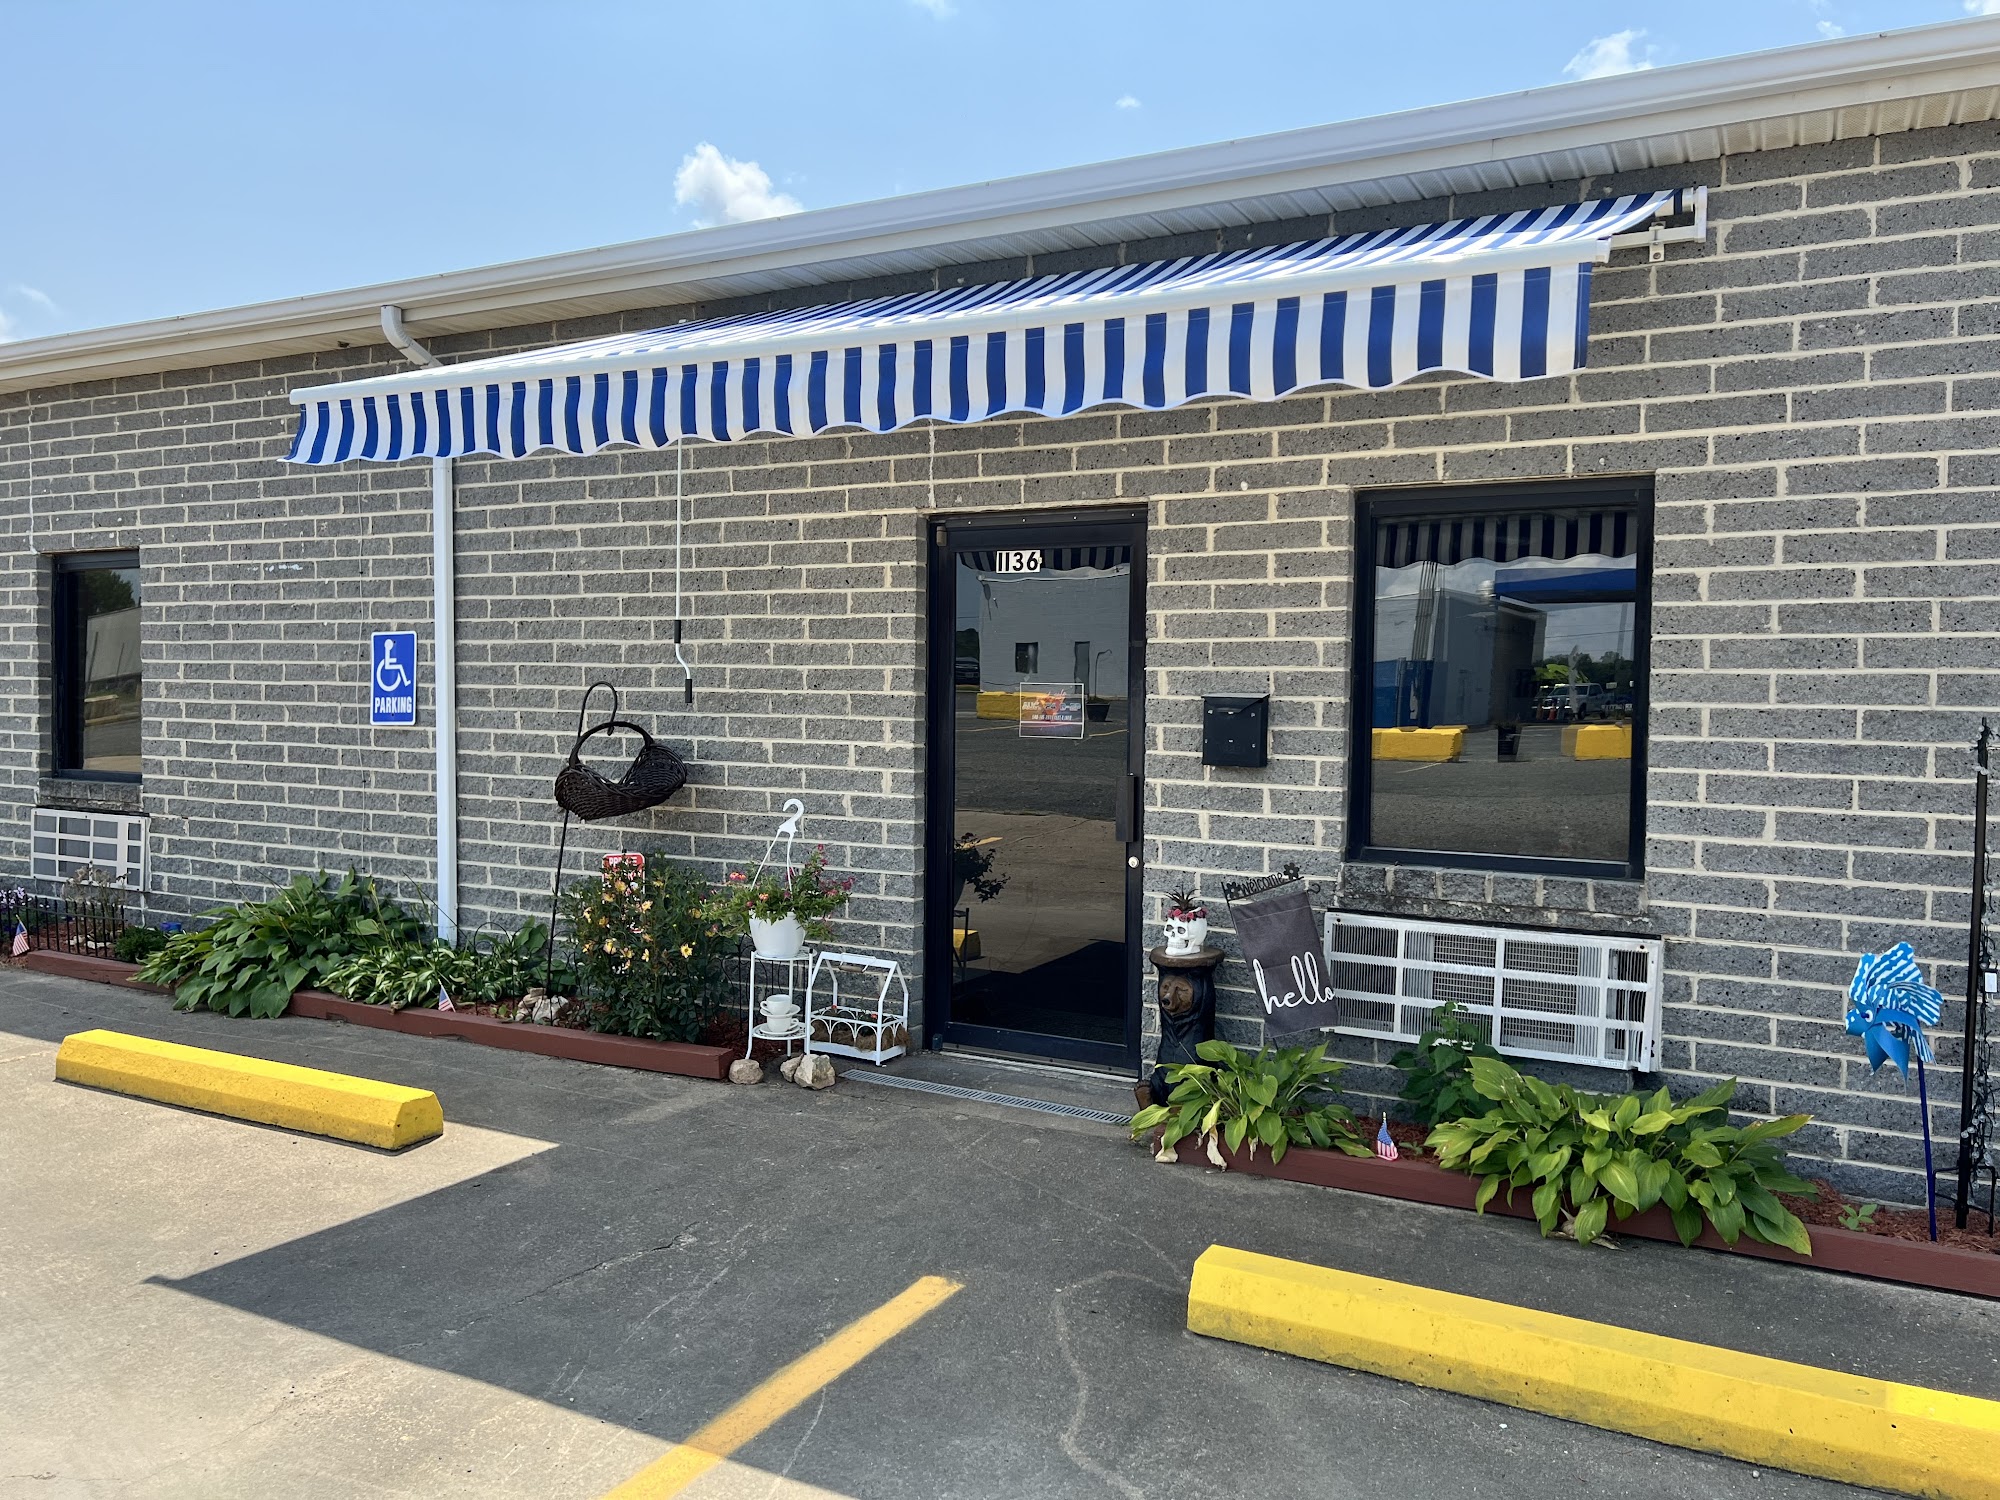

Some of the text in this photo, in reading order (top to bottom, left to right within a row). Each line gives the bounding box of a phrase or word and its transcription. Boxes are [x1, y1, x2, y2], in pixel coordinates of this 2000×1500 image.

[998, 551, 1038, 571] 1136
[374, 696, 412, 713] PARKING
[1252, 951, 1336, 1014] hello
